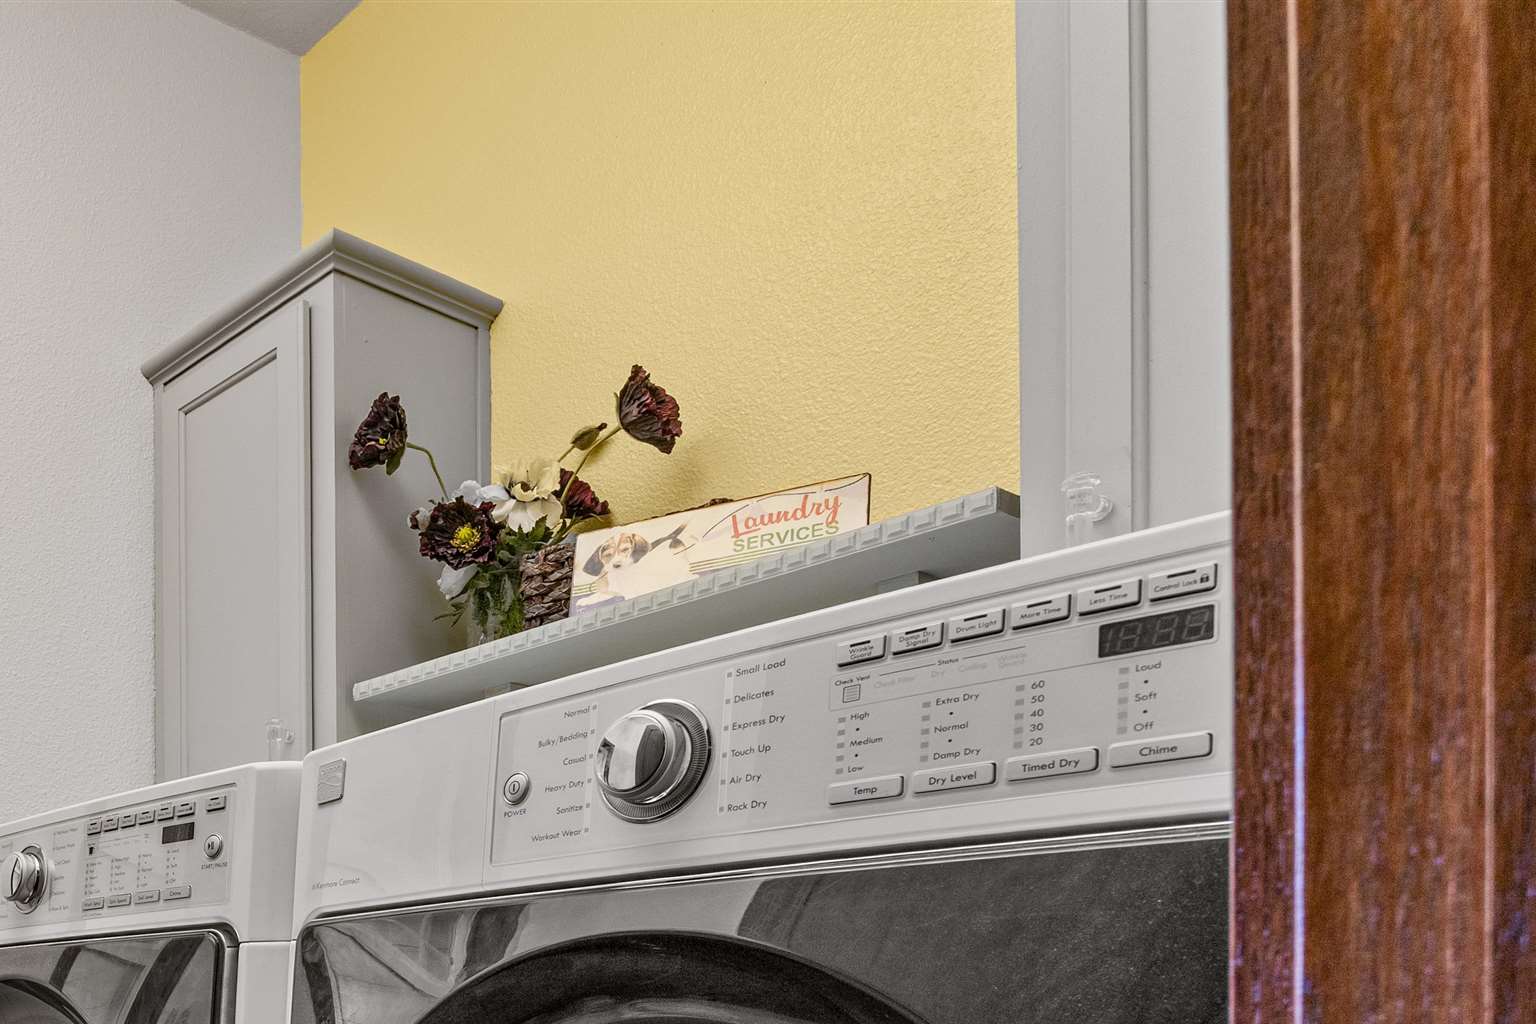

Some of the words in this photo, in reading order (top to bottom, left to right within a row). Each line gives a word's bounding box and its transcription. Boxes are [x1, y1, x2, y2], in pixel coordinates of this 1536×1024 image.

[731, 494, 842, 538] Laundry
[733, 521, 839, 553] SERVICES
[1043, 607, 1061, 615] Time
[735, 664, 761, 677] Small
[763, 659, 786, 671] Load
[1135, 661, 1162, 672] Loud
[1031, 680, 1045, 689] 60
[734, 688, 774, 703] Delicates
[936, 697, 960, 707] Extra
[963, 692, 979, 702] Dry
[1031, 694, 1045, 704] 50
[1134, 692, 1157, 703] Soft
[564, 706, 591, 719] Normal
[850, 711, 869, 722] High
[1030, 709, 1044, 718] 40
[732, 717, 766, 731] Express
[768, 713, 785, 724] Dry
[934, 721, 968, 734] Normal
[1029, 723, 1044, 732] 30
[1133, 721, 1154, 733] Off
[850, 736, 883, 747] Medium
[1029, 737, 1043, 747] 20
[731, 746, 755, 758] Touch
[757, 743, 771, 754] Up
[933, 749, 960, 761] Damp
[963, 746, 981, 756] Dry
[1139, 743, 1178, 757] Chime
[563, 753, 587, 766] Casual
[847, 765, 864, 774] Low
[1022, 761, 1055, 775] Timed
[1060, 758, 1080, 770] Dry
[567, 778, 585, 791] Duty
[729, 774, 742, 785] Air
[745, 773, 762, 784] Dry
[928, 775, 946, 786] Dry
[949, 771, 977, 783] Level
[854, 784, 877, 797] Temp
[503, 808, 527, 818] POWER
[556, 804, 584, 815] Sanitize
[727, 801, 748, 813] Rack
[750, 800, 767, 811] Dry
[561, 828, 582, 838] Wear
